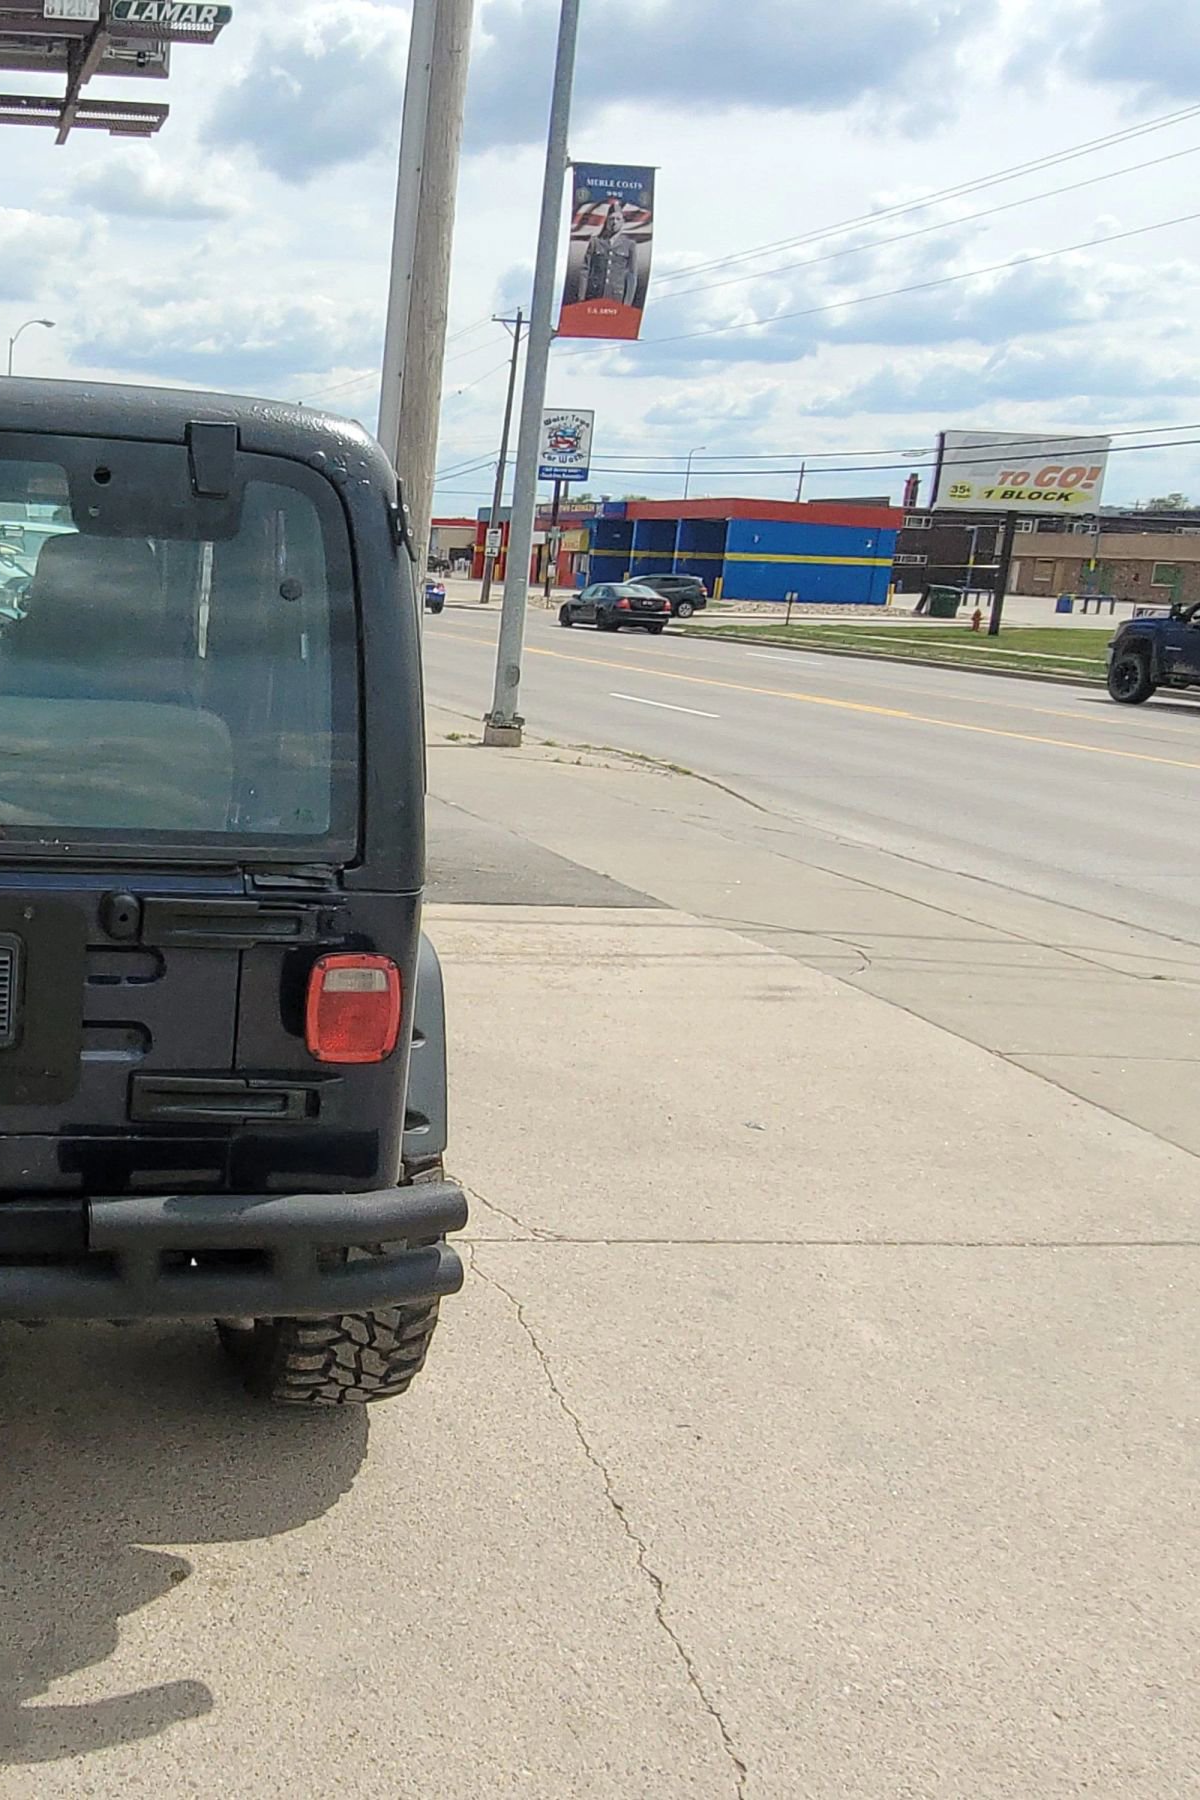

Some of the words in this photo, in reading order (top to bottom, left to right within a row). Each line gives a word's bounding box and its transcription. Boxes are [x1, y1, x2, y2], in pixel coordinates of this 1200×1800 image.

[126, 0, 218, 22] LAMAR
[998, 471, 1030, 486] TO
[1034, 465, 1102, 488] GO!
[984, 490, 995, 499] 1
[1000, 491, 1075, 502] BLOCK
